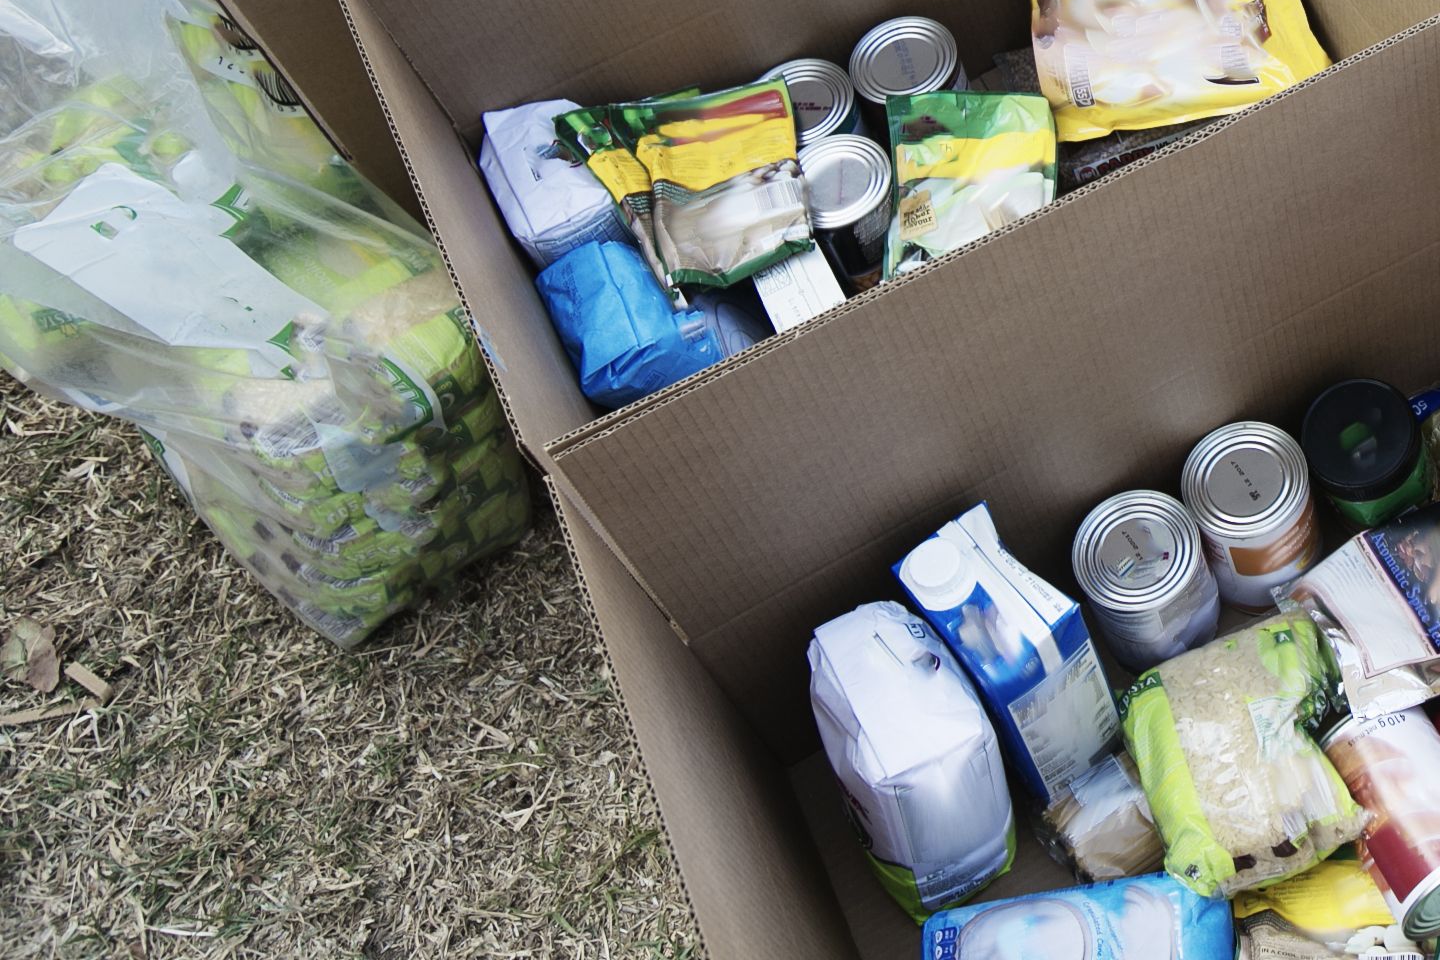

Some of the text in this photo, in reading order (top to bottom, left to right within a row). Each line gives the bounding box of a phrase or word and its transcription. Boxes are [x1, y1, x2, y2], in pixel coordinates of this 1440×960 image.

[1371, 532, 1410, 589] Aromatic
[1406, 582, 1431, 624] Spice
[1387, 713, 1407, 727] 410
